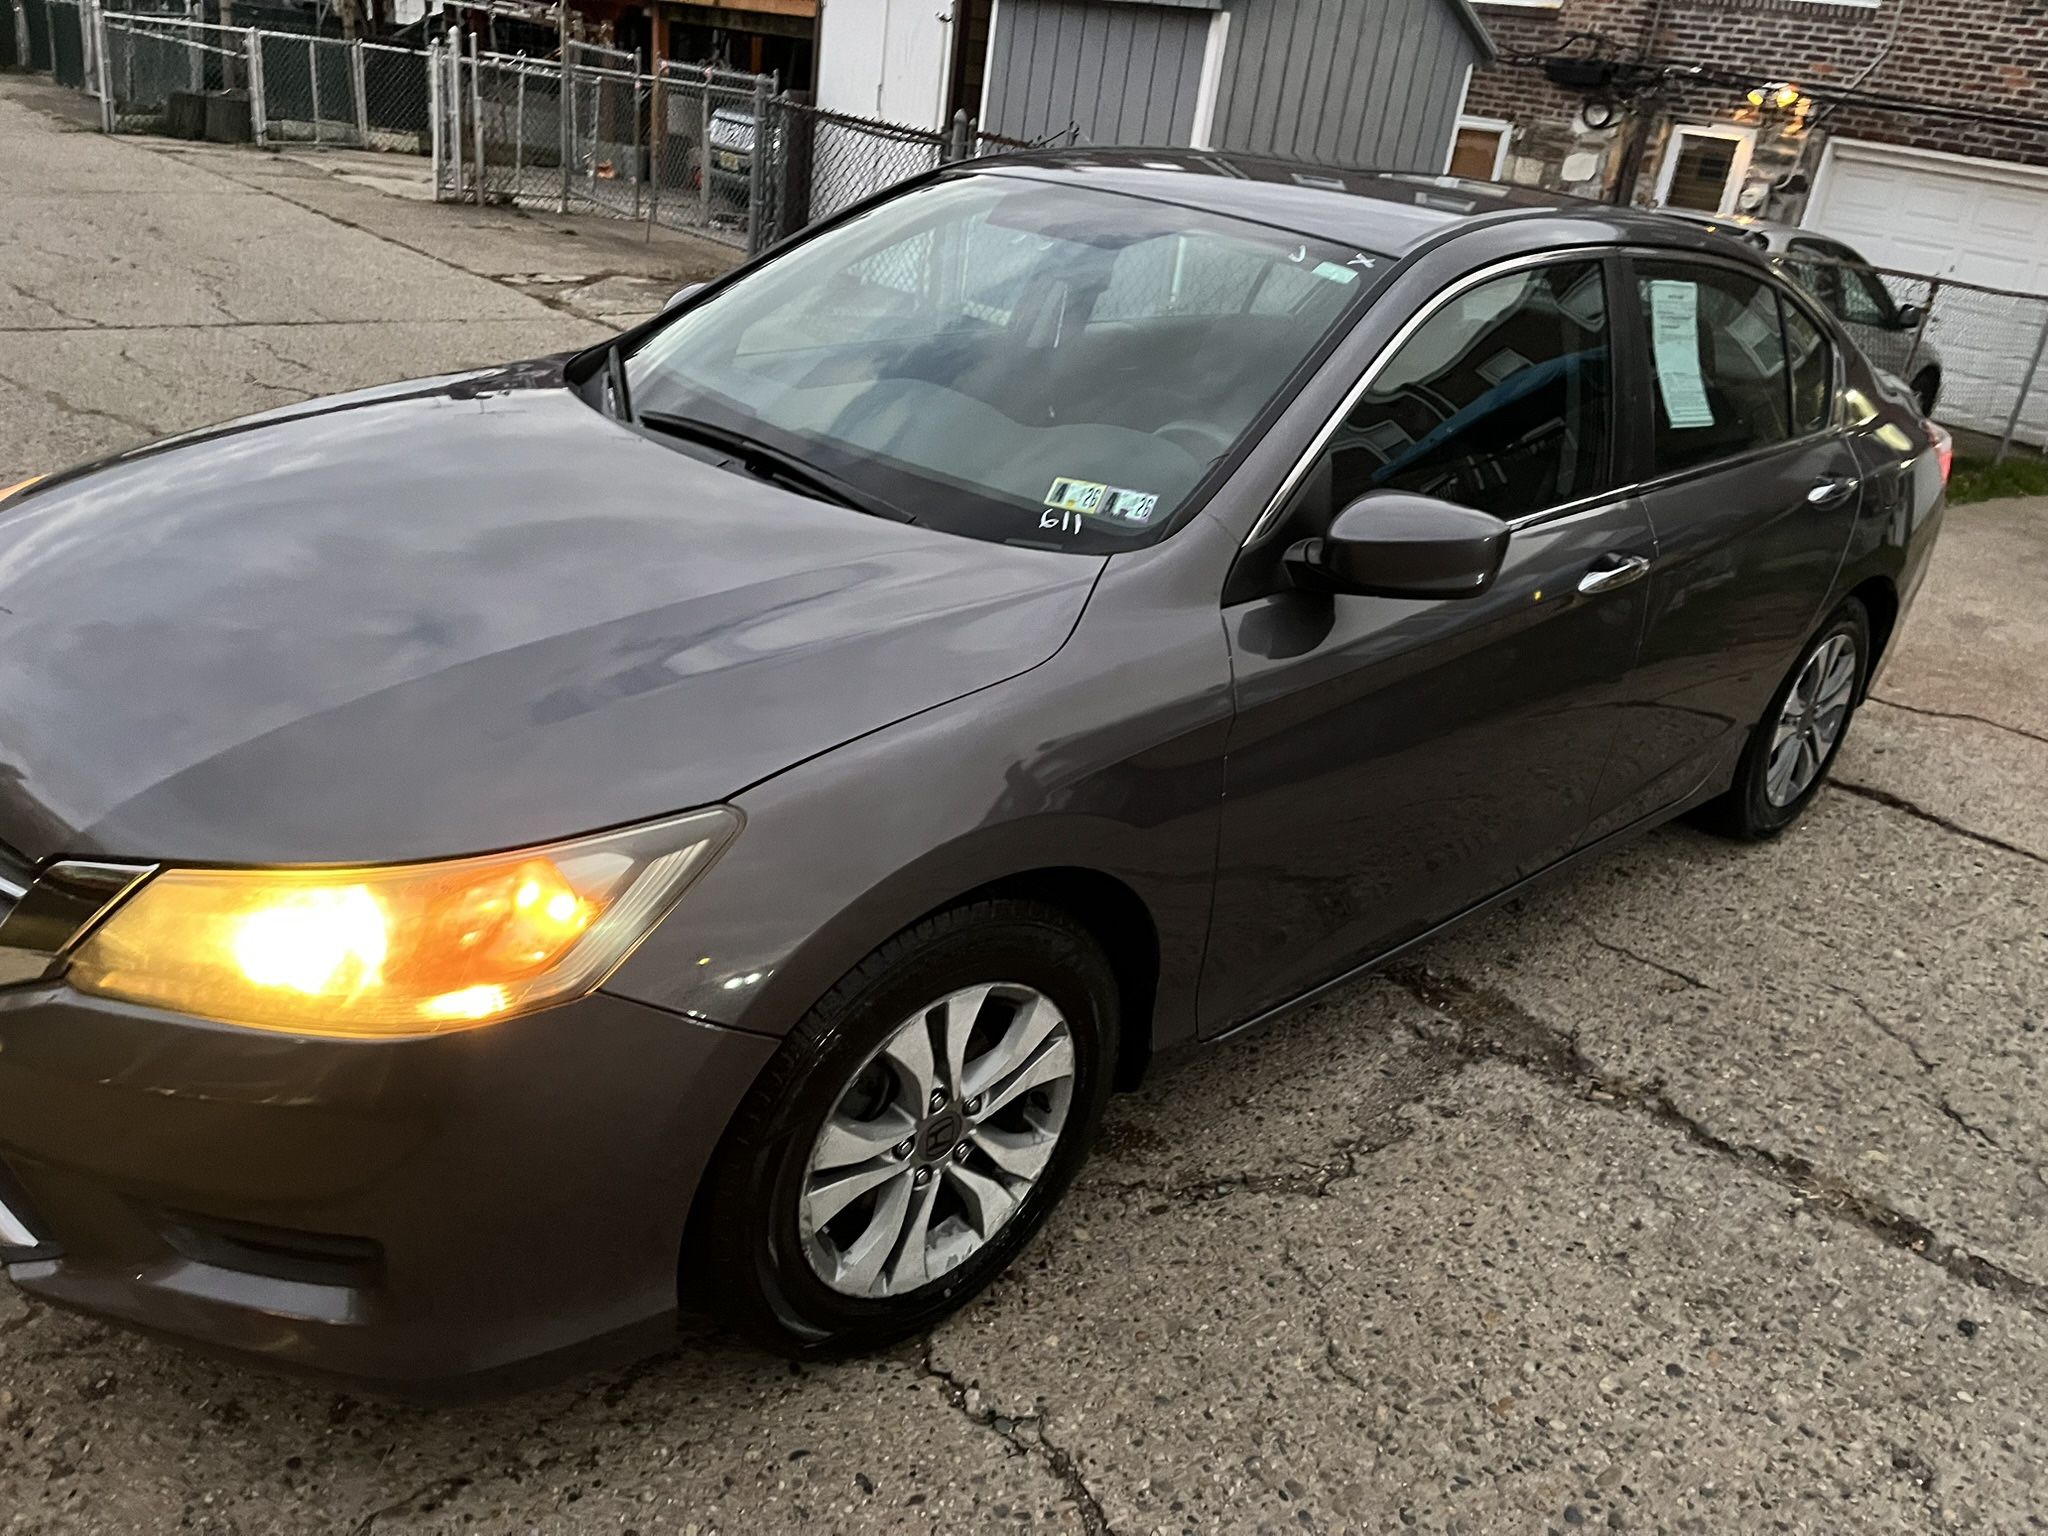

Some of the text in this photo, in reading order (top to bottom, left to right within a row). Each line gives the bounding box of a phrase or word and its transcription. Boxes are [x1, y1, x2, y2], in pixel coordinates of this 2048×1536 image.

[1083, 487, 1101, 508] 26
[1134, 497, 1154, 517] 26
[1038, 508, 1082, 535] 611
